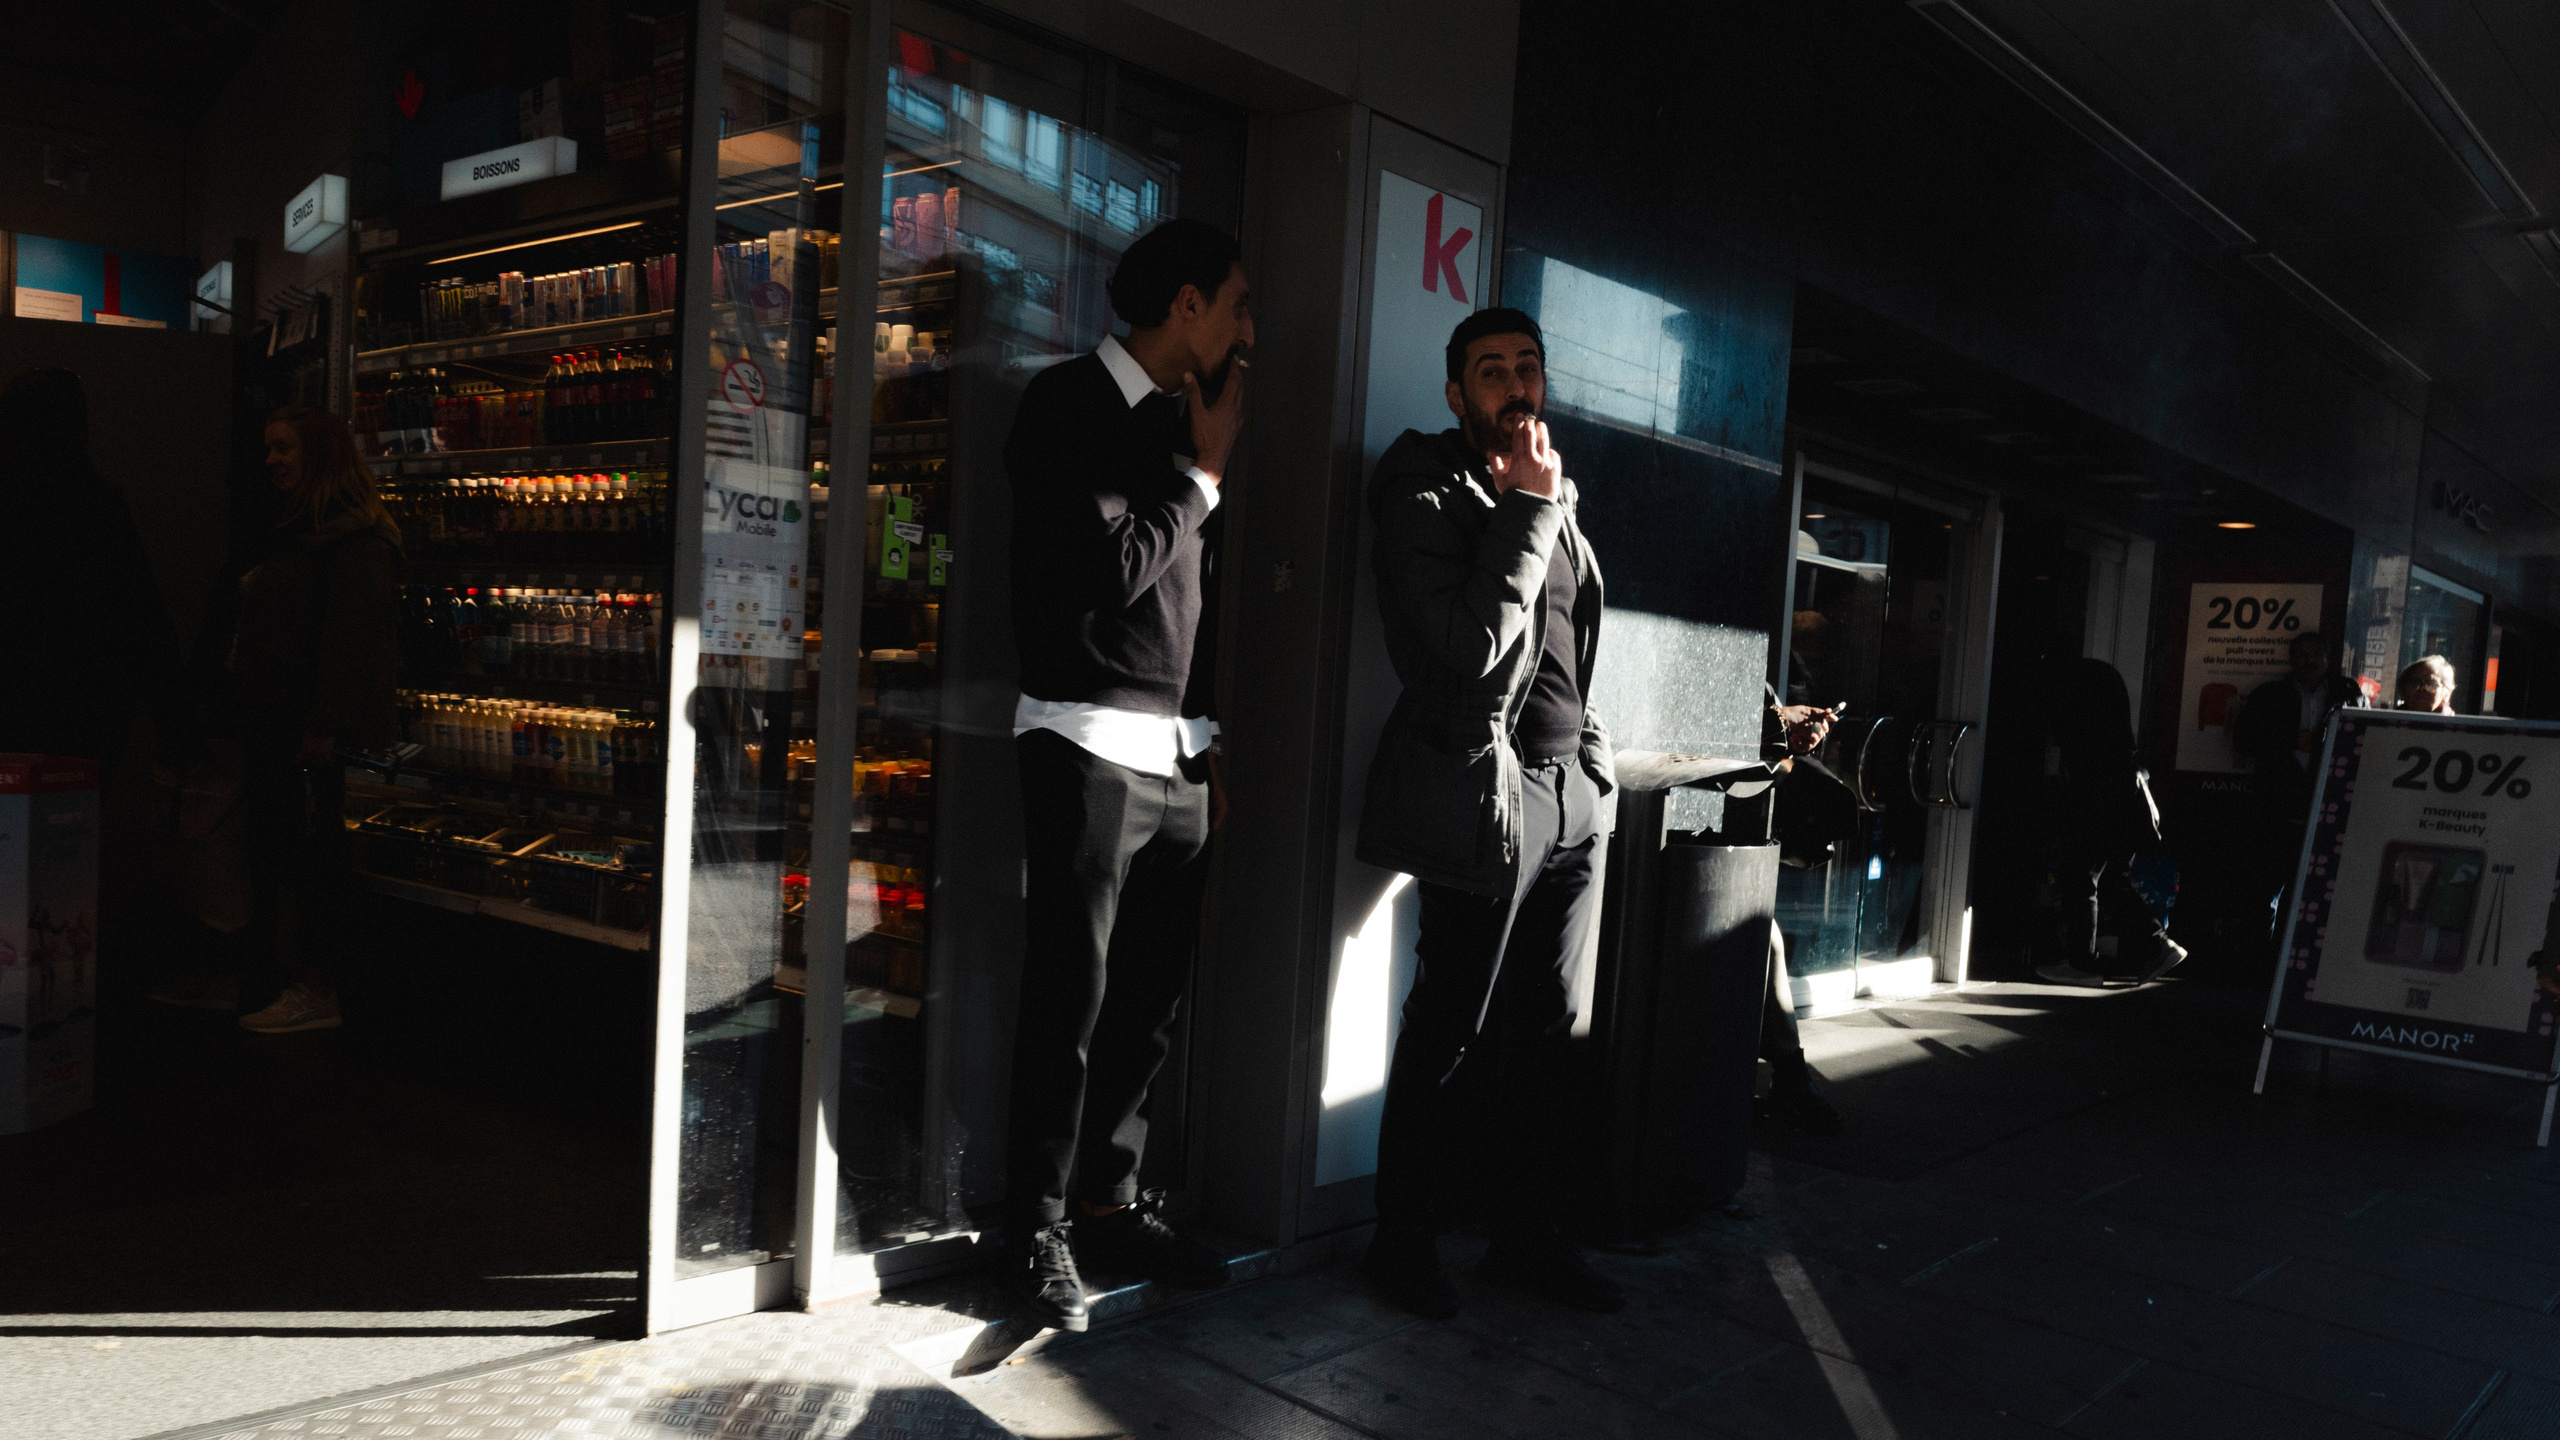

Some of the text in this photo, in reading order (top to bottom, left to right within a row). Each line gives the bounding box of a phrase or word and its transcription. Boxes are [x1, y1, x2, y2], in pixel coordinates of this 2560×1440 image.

[472, 157, 521, 181] BOISSONS
[291, 197, 315, 228] SERVICES
[1422, 192, 1474, 305] k
[703, 480, 779, 522] Lyca
[735, 520, 778, 538] Mobile
[2206, 595, 2301, 632] 20%
[2207, 635, 2293, 646] nouvelle collectio
[2225, 646, 2275, 656] pull-overs
[2202, 655, 2215, 665] de
[2216, 656, 2226, 665] la
[2226, 657, 2265, 668] marque
[2391, 745, 2532, 800] 20%
[2422, 804, 2488, 822] marques
[2418, 819, 2487, 837] K-Beauty
[2350, 1019, 2461, 1053] MANOR
